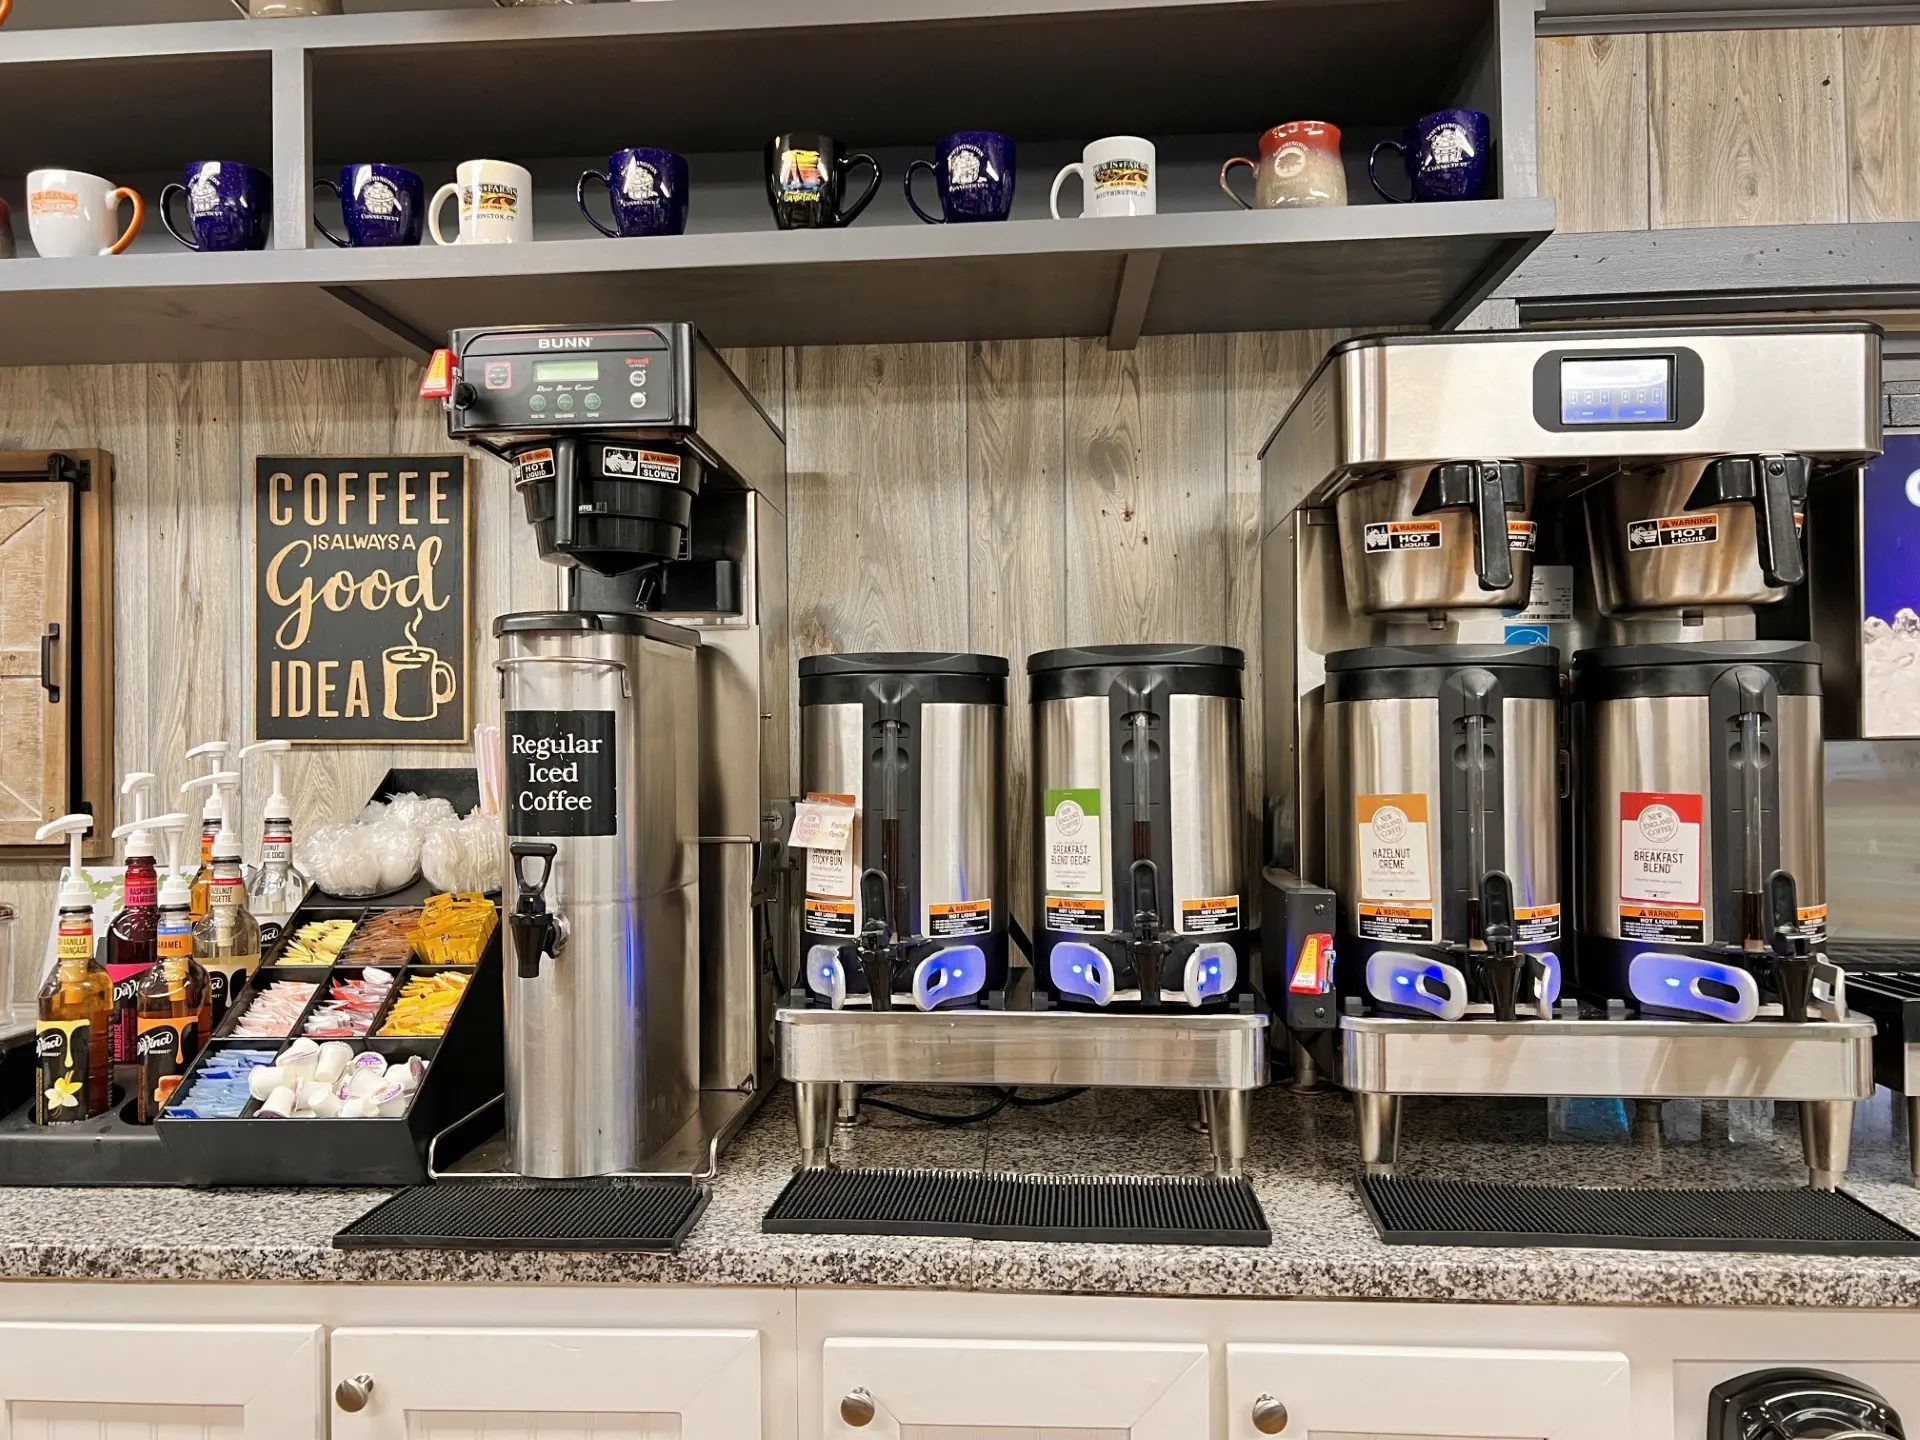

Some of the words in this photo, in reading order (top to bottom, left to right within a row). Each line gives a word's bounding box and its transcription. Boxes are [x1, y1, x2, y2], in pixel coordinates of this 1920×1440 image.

[538, 336, 592, 349] BUNN
[525, 462, 545, 473] HOT
[525, 470, 546, 479] LIQUID
[643, 468, 676, 480] SLOWLY
[269, 471, 450, 526] COFFEE
[1399, 523, 1436, 532] WARNING
[1671, 517, 1712, 527] WARNING
[1398, 534, 1431, 543] HOT
[1671, 528, 1706, 539] HOT
[1671, 535, 1706, 544] LIQUID
[312, 534, 329, 550] IS
[330, 534, 401, 550] ALWAYS
[401, 534, 416, 550] A
[265, 535, 450, 650] Good
[271, 659, 370, 718] IDEA
[511, 733, 603, 760] Regular
[528, 762, 579, 783] Iced
[519, 790, 592, 811] Coffee
[1052, 845, 1088, 854] BREAKFAST
[1372, 848, 1411, 859] HAZELNUT
[812, 855, 829, 866] STICKY
[829, 856, 843, 867] BUN
[1633, 850, 1684, 864] BREAKFAST
[1643, 862, 1671, 874] BLEND
[1383, 909, 1411, 917] WARNING
[1648, 910, 1679, 918] WARNING
